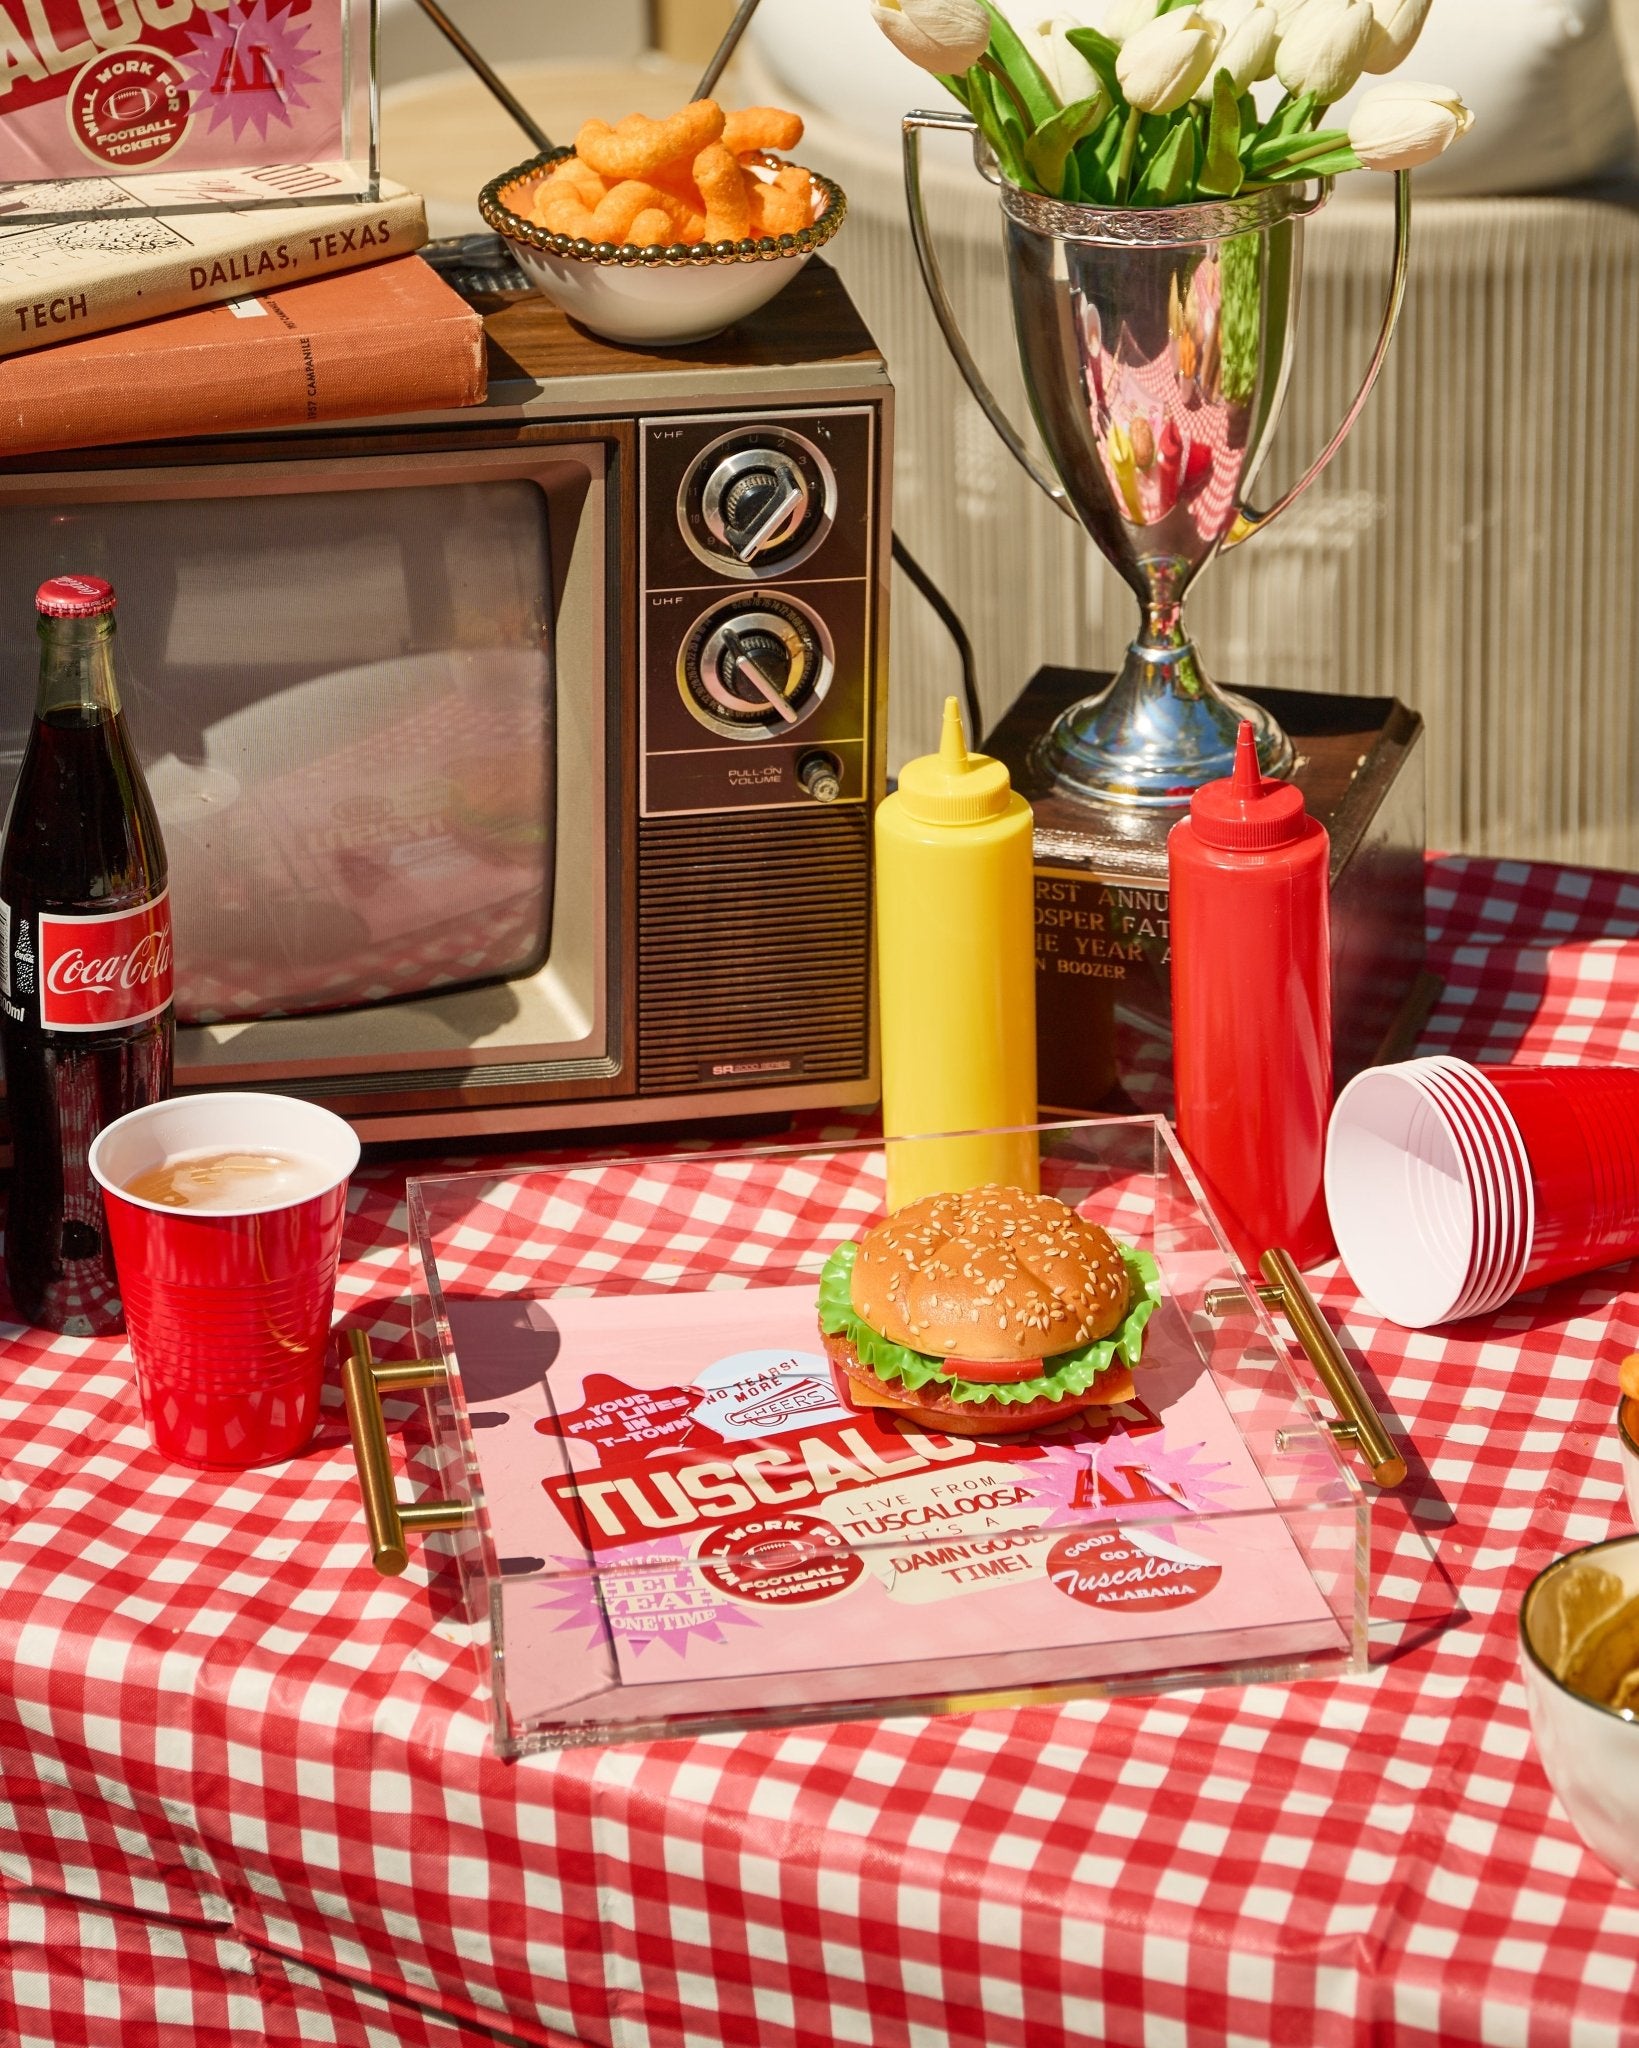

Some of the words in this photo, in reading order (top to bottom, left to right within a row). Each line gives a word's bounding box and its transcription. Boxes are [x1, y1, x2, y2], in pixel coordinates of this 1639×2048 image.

[82, 88, 99, 138] WILL
[96, 60, 154, 84] WORK
[156, 71, 180, 112] FOR
[96, 119, 176, 146] FOOTBALL
[106, 133, 172, 156] TICKETS
[15, 293, 88, 332] TECH
[190, 246, 299, 291] DALLAS,
[309, 219, 391, 261] TEXAS
[300, 337, 317, 396] CAMPANILE
[653, 431, 684, 439] VHF
[653, 597, 684, 606] UHF
[728, 767, 782, 777] PULL-ON
[729, 775, 782, 786] VOLUME
[47, 922, 170, 995] Coca-Cola
[1075, 937, 1144, 962] YEAR
[1057, 959, 1126, 979] BOOZER
[706, 1389, 728, 1405] NO
[733, 1358, 799, 1391] TEARS!
[734, 1377, 782, 1403] MORE
[568, 1414, 613, 1434] FAV
[616, 1396, 690, 1421] LIVES
[587, 1393, 653, 1416] YOUR
[743, 1390, 826, 1420] CHEERS
[597, 1417, 692, 1448] T-TOWN
[623, 1417, 652, 1432] IN
[846, 1494, 911, 1516] LIVE
[930, 1476, 997, 1498] FROM
[843, 1487, 1036, 1537] TUSCALOOSA
[985, 1517, 1000, 1527] A
[725, 1520, 803, 1541] WORK
[889, 1545, 971, 1574] DAMN
[972, 1525, 1048, 1555] GOOD
[1064, 1534, 1115, 1558] GOOD
[1100, 1550, 1130, 1561] GO
[738, 1564, 849, 1592] FOOTBALL
[941, 1554, 1033, 1584] TIME!
[755, 1575, 845, 1600] TICKETS
[1096, 1584, 1197, 1603] ALABAMA
[610, 1615, 659, 1632] ONE
[659, 1609, 717, 1631] TIME
